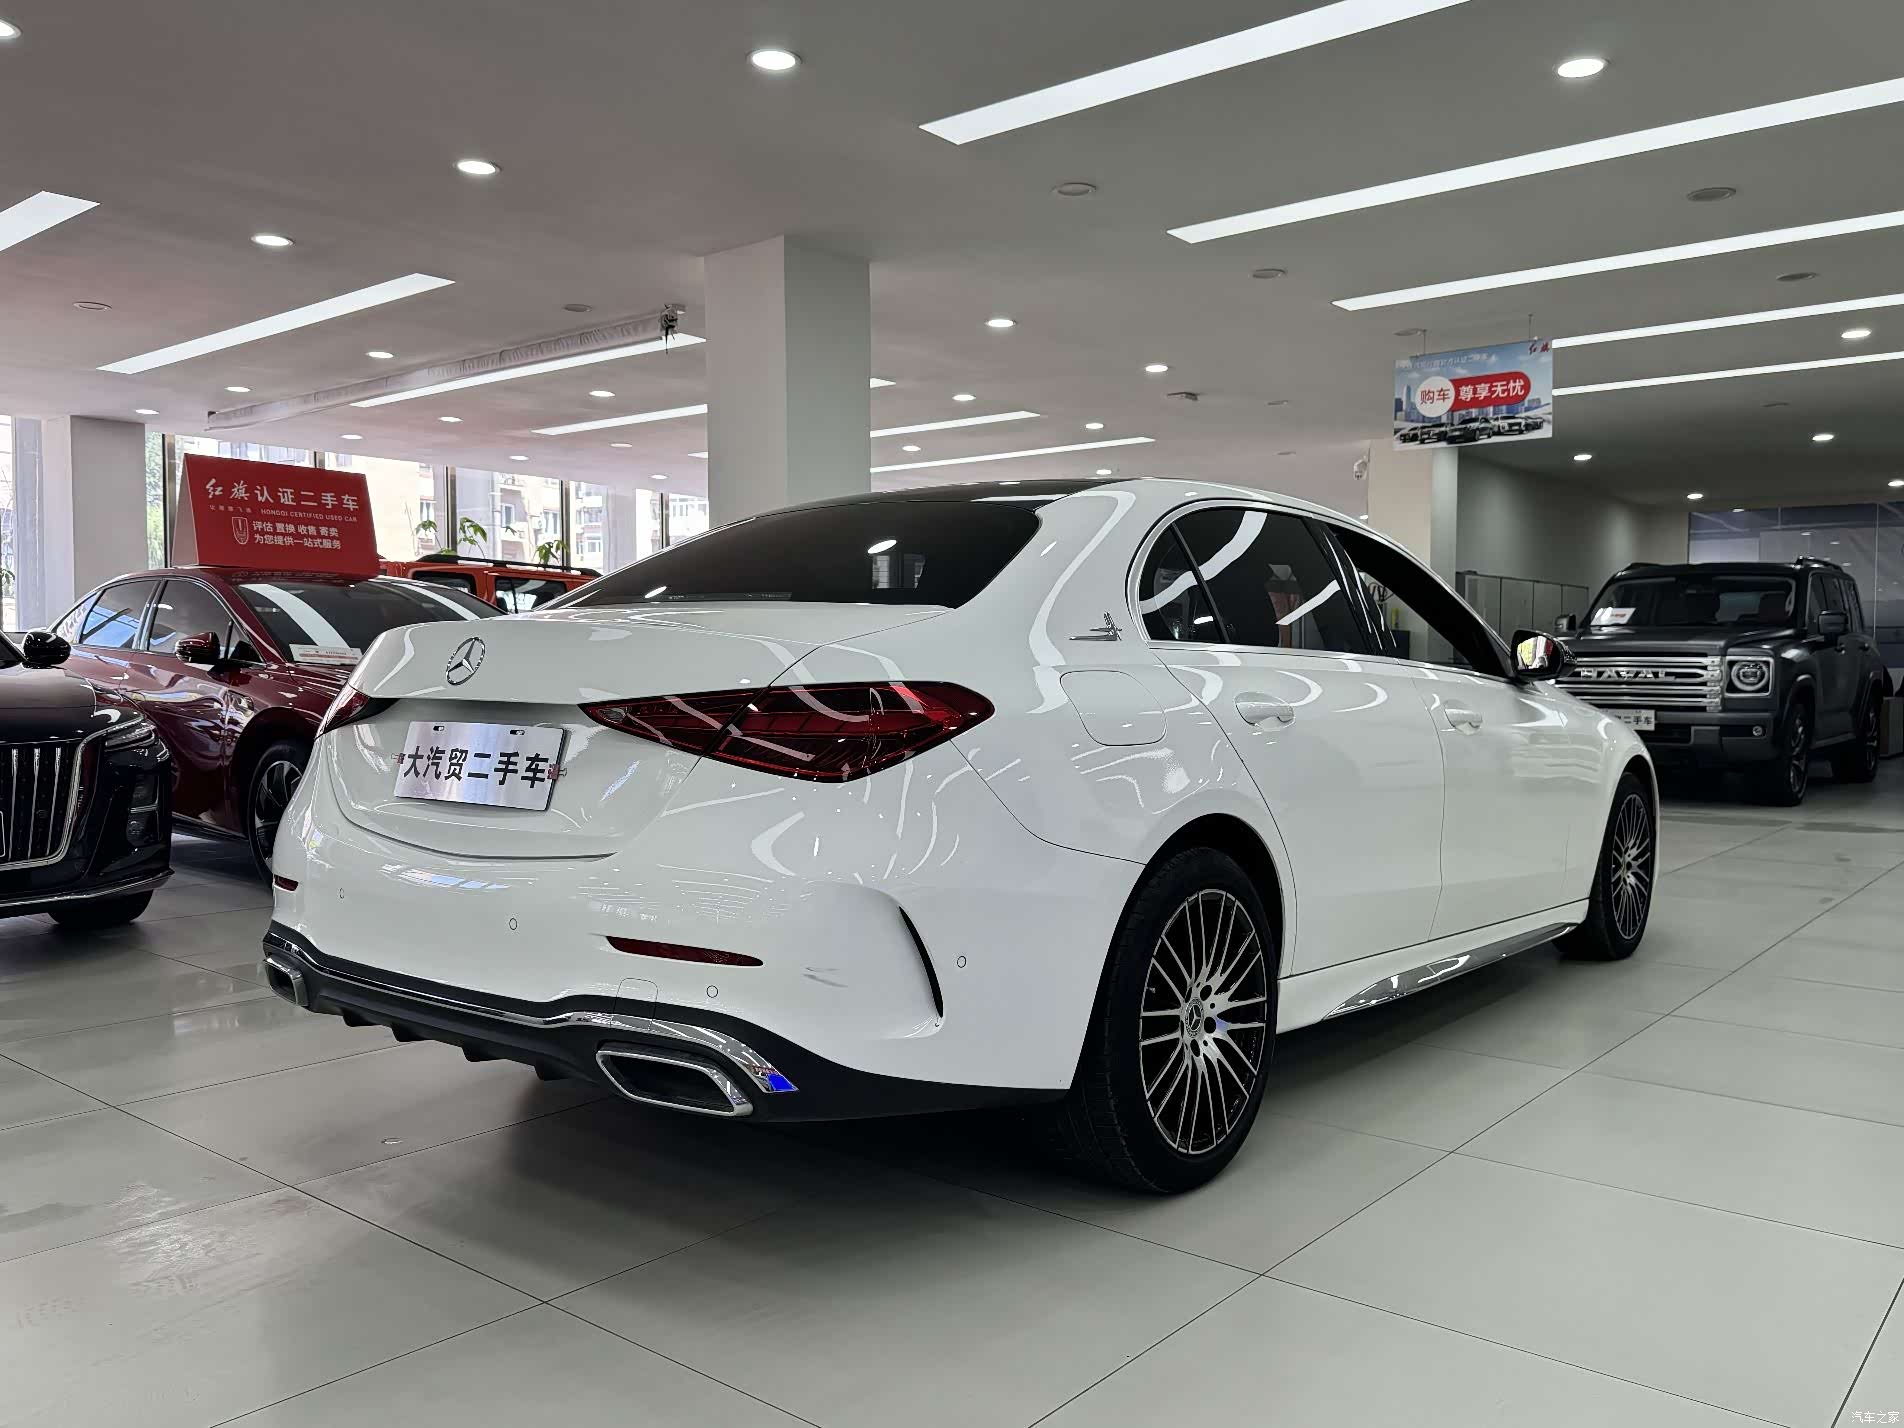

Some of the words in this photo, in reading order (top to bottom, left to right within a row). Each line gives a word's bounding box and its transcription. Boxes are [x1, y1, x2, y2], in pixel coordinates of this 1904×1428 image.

[1420, 387, 1451, 405] 购车
[1458, 378, 1525, 402] 尊享无忧
[260, 508, 289, 517] HONGQI
[290, 511, 324, 520] CERTIFIED
[325, 514, 343, 522] USED
[252, 521, 274, 532] 评估
[275, 523, 296, 534] 置换
[319, 526, 340, 537] 寄卖
[254, 533, 342, 550] 为您提供一站式服务
[1580, 668, 1676, 681] HAVAL
[403, 745, 549, 789] 大汽贸二手车
